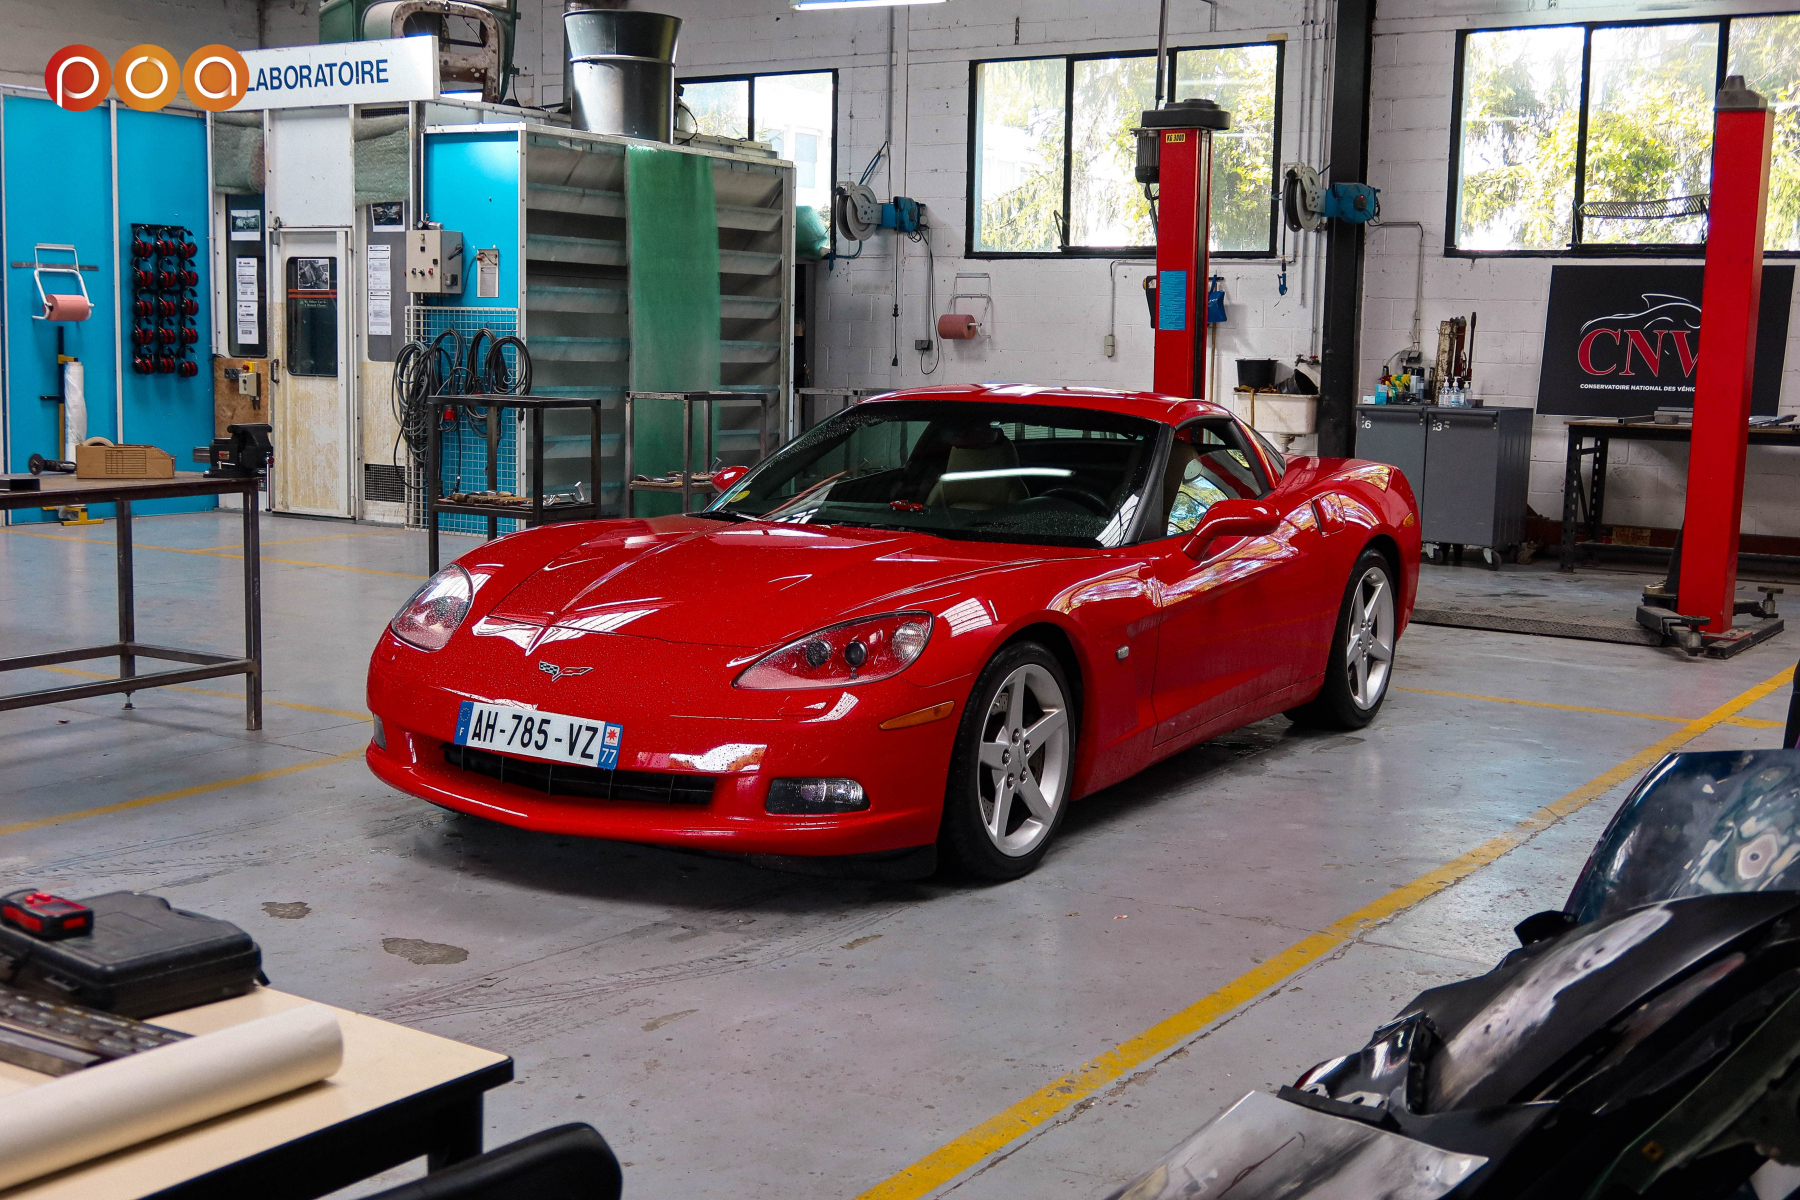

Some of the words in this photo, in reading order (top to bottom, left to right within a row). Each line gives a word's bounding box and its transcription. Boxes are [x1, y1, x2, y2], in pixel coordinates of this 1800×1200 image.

[1364, 420, 1372, 429] 6
[1436, 422, 1443, 431] 3
[458, 726, 465, 736] F
[601, 747, 617, 764] 77
